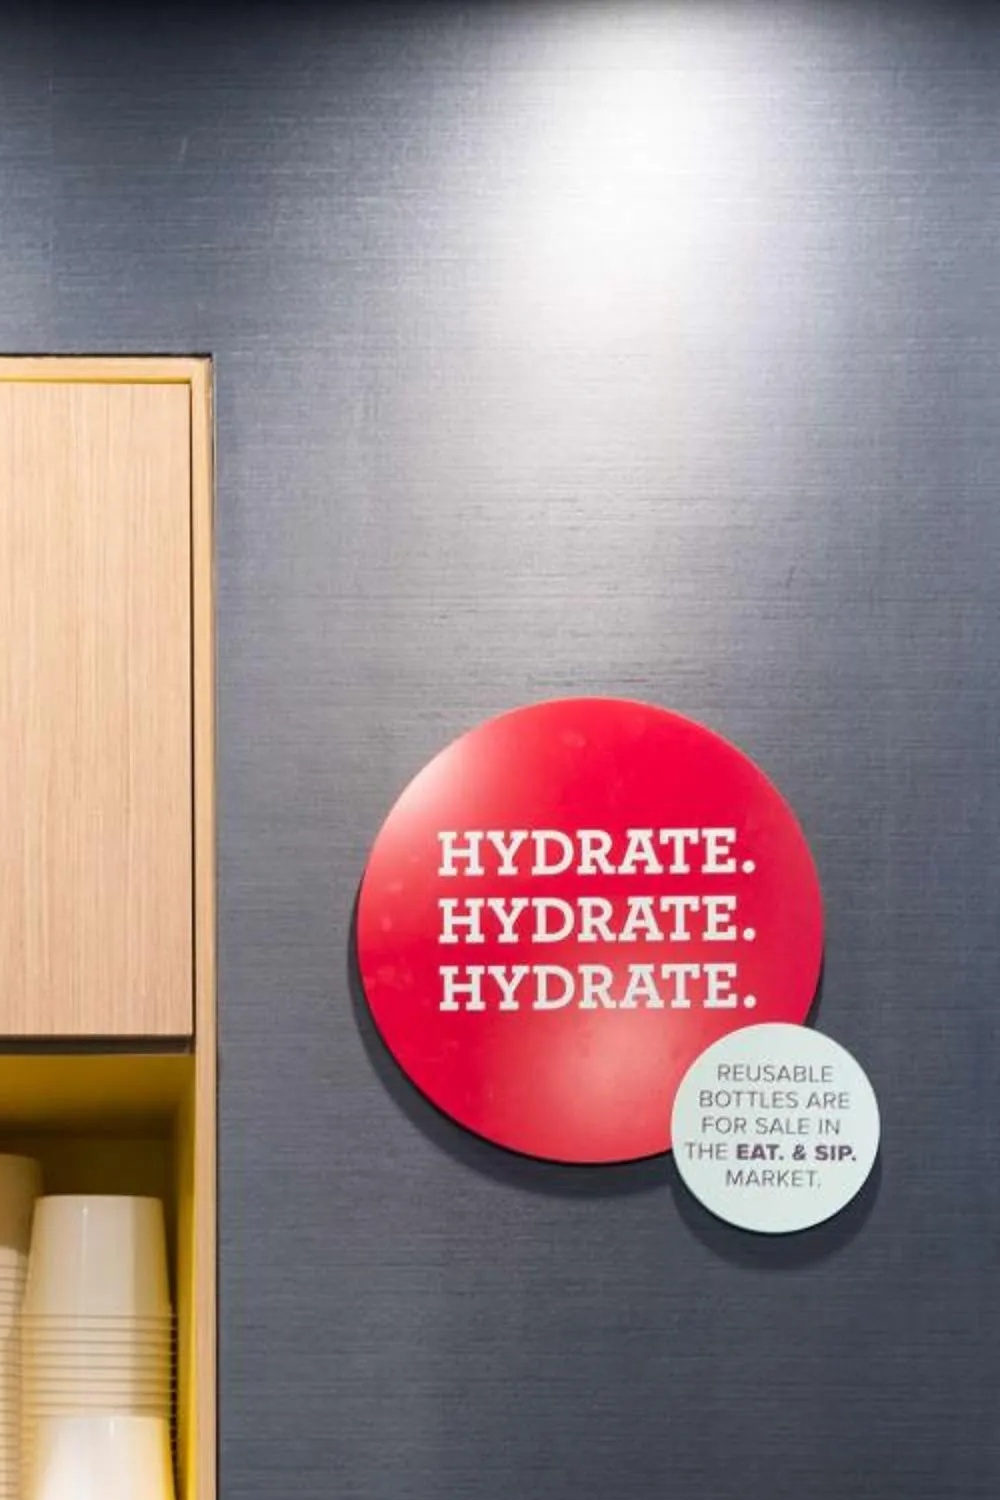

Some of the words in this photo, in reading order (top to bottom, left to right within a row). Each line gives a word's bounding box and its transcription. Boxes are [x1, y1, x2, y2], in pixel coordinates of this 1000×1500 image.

[438, 828, 756, 876] HYDRATE.
[438, 896, 756, 943] HYDRATE.
[439, 963, 757, 1011] HYDRATE.
[717, 1064, 834, 1083] REUSABLE
[699, 1090, 799, 1109] BOTTLES
[806, 1091, 850, 1109] ARE
[701, 1116, 747, 1135] FOR
[755, 1117, 810, 1135] SALE
[818, 1118, 841, 1135] IN
[685, 1142, 728, 1160] THE
[736, 1143, 785, 1161] EAT.
[792, 1144, 806, 1161] &
[814, 1145, 857, 1162] SIP.
[725, 1169, 821, 1188] MARKET.
